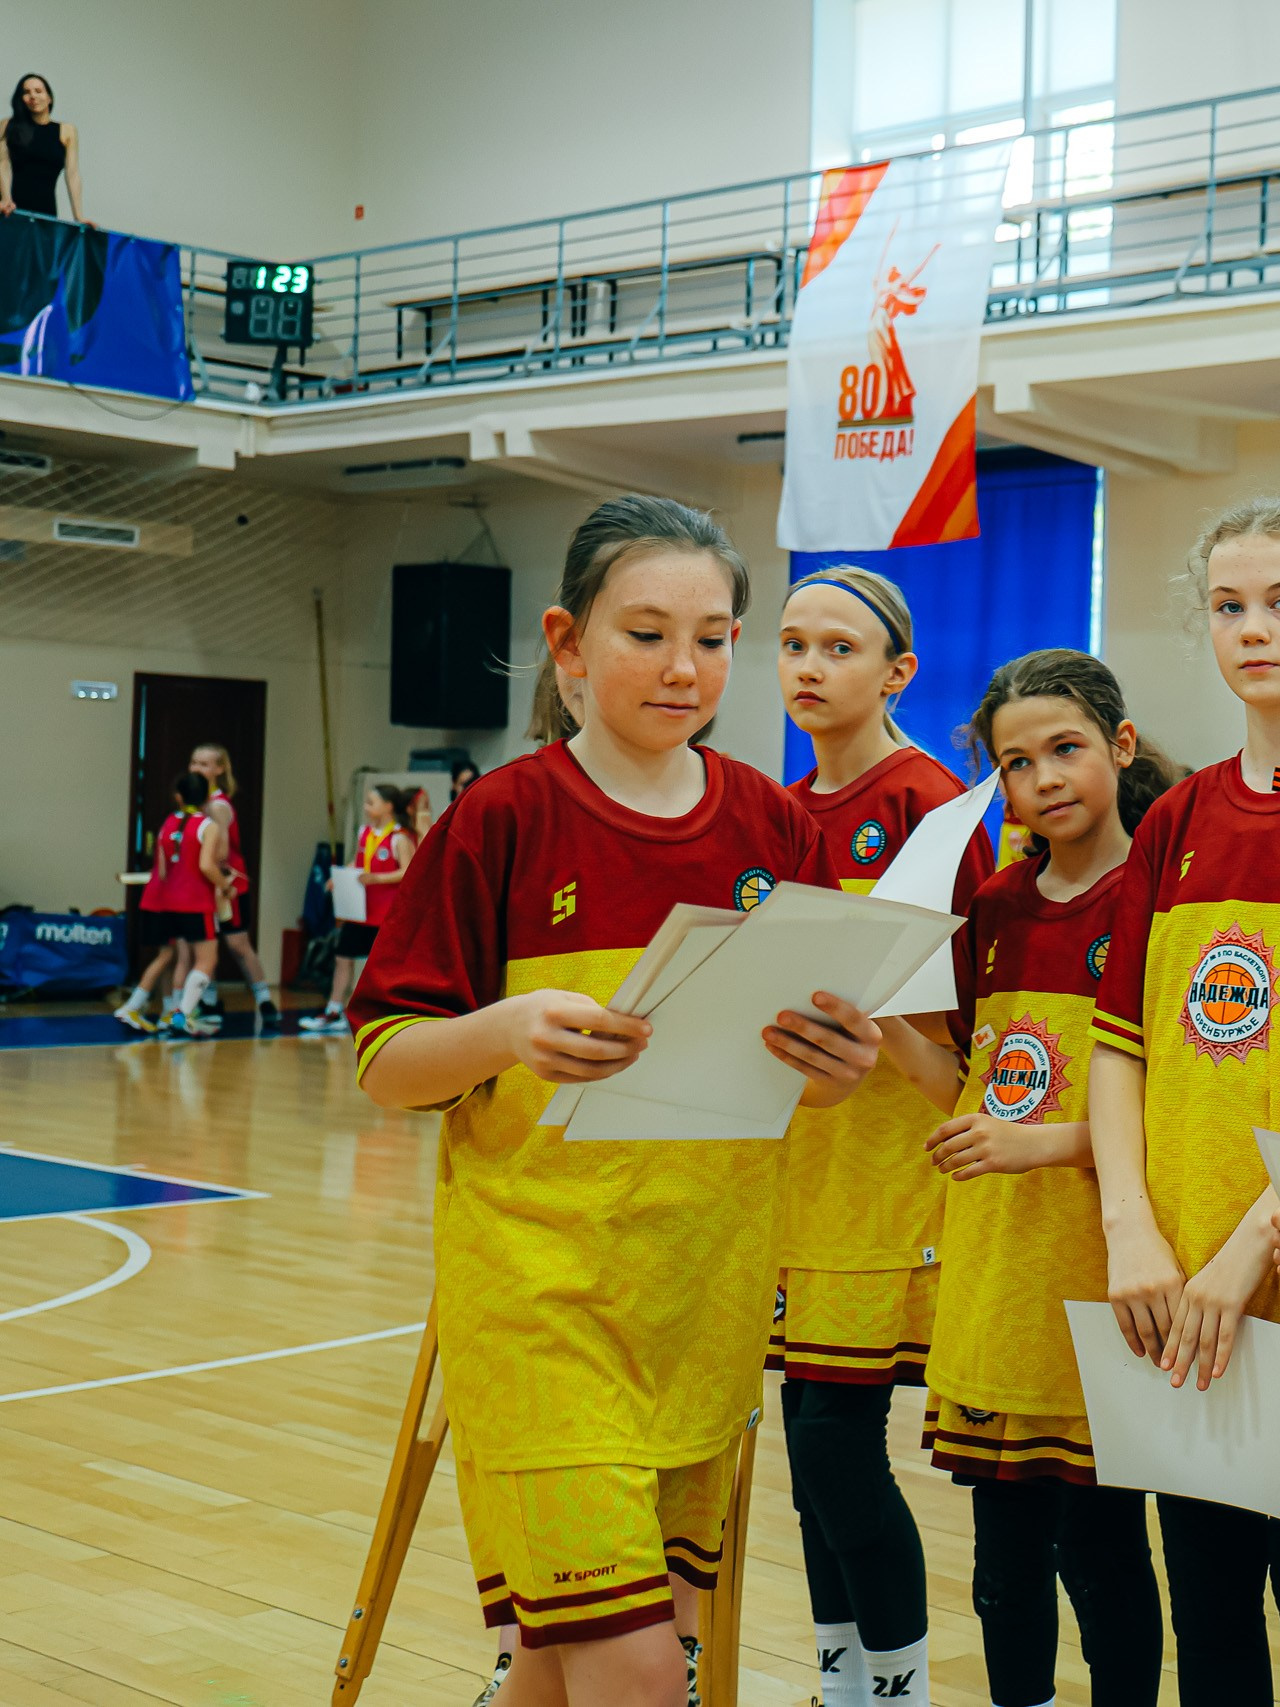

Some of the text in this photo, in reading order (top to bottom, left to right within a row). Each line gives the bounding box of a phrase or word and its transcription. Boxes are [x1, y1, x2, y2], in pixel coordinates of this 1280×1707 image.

[838, 364, 881, 421] 80
[834, 429, 914, 463] ПОБЕДА!
[36, 922, 112, 945] molten
[1190, 982, 1269, 1010] НАДЕЖДА
[1195, 1013, 1259, 1038] ОРЕНБУРЖЬЕ
[991, 1068, 1048, 1090] АДЕЖДА
[986, 1094, 1035, 1117] ОРЕНБУРЖЬЕ
[574, 1564, 618, 1582] SPORT
[872, 1668, 916, 1697] 2K
